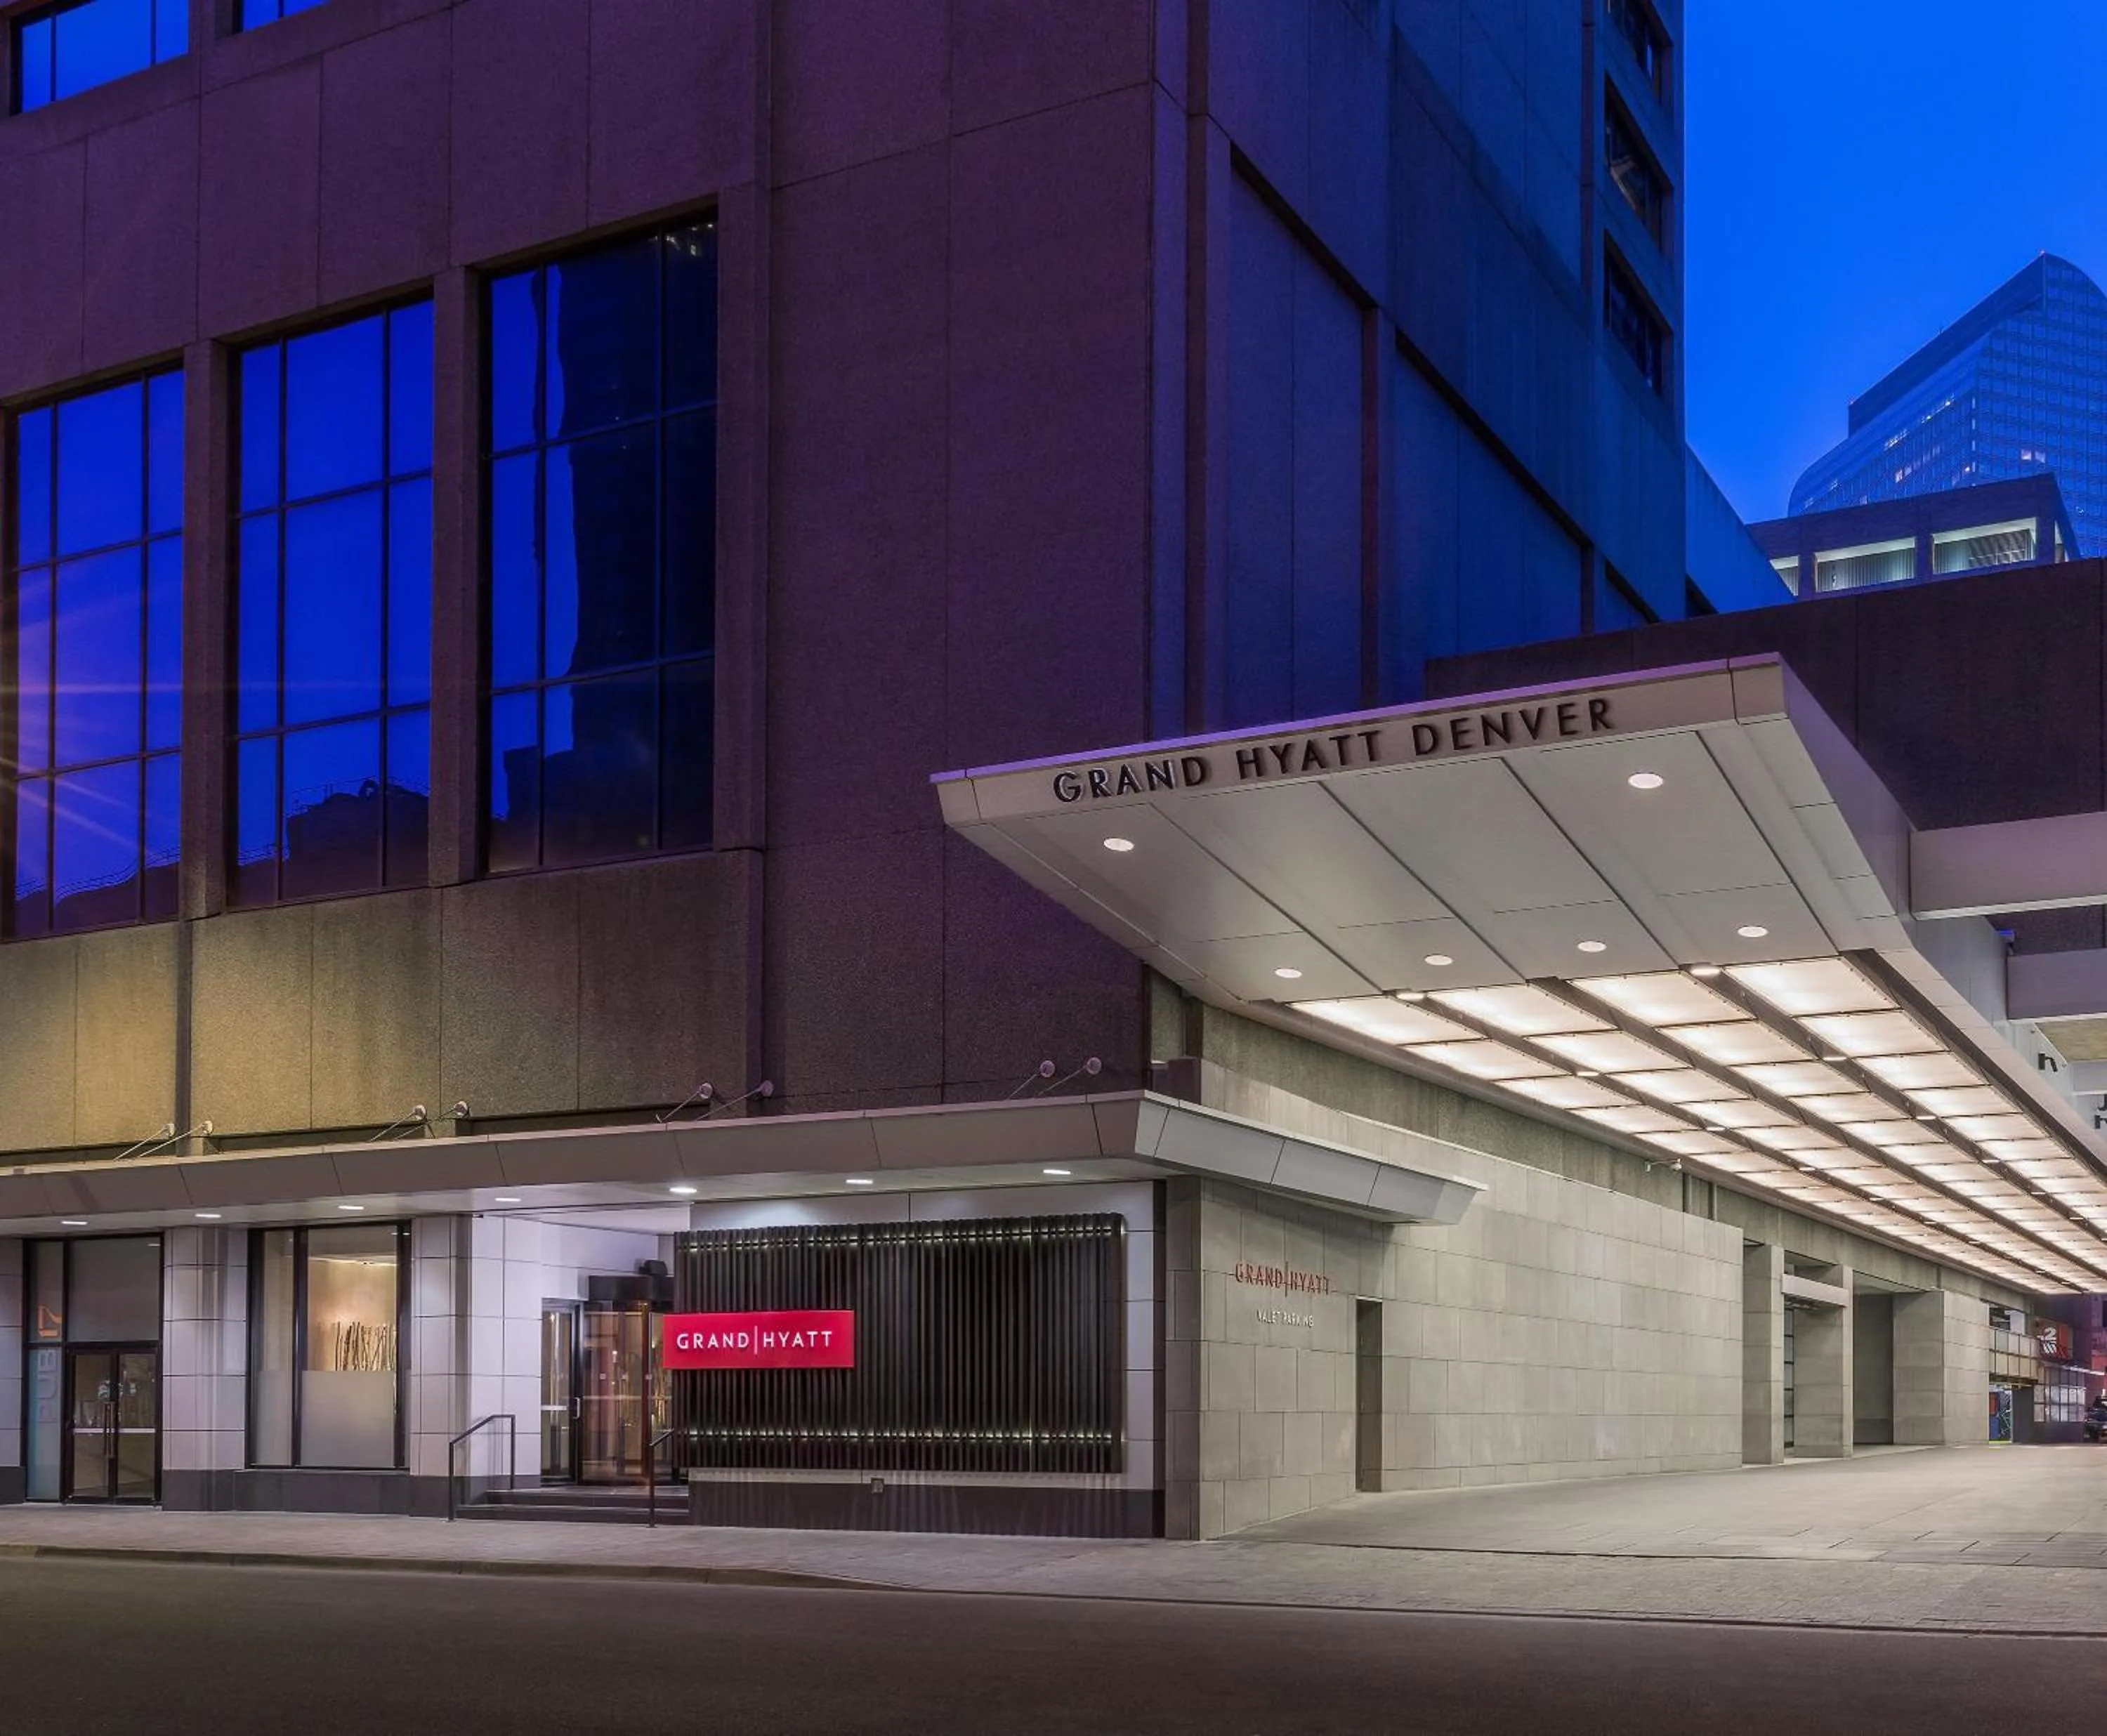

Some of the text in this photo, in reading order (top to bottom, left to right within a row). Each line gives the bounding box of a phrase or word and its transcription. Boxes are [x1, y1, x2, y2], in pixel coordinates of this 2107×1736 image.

[1053, 698, 1614, 803] GRAND HYATT DENVER
[1235, 1263, 1330, 1295] GRAND HYATT
[1282, 1311, 1315, 1328] PARKNG
[676, 1331, 832, 1349] GRAND HYATT
